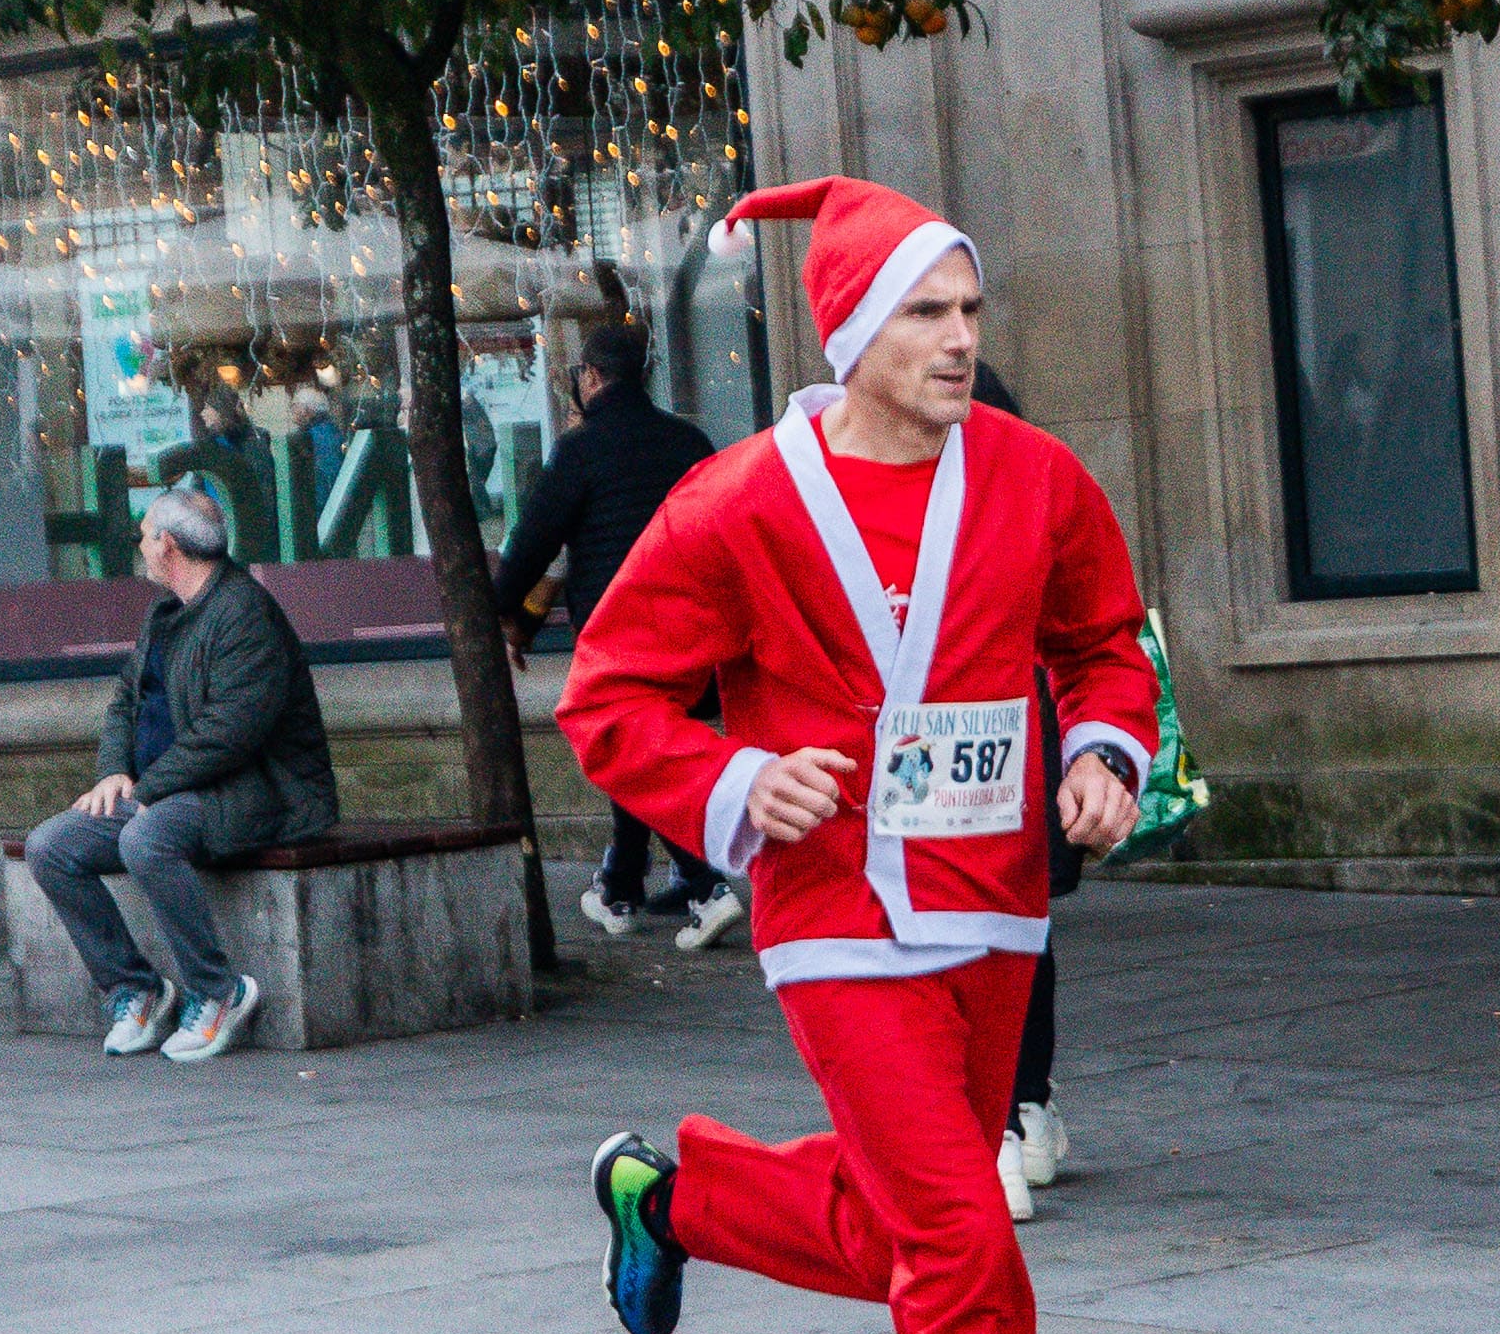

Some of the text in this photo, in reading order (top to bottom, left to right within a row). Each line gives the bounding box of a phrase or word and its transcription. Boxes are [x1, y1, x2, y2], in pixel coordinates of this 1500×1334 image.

[925, 710, 956, 736] SAN
[961, 705, 1021, 736] SILVESTRE
[950, 736, 1012, 783] 587
[934, 784, 1016, 808] PONTEVEDRA 2025
